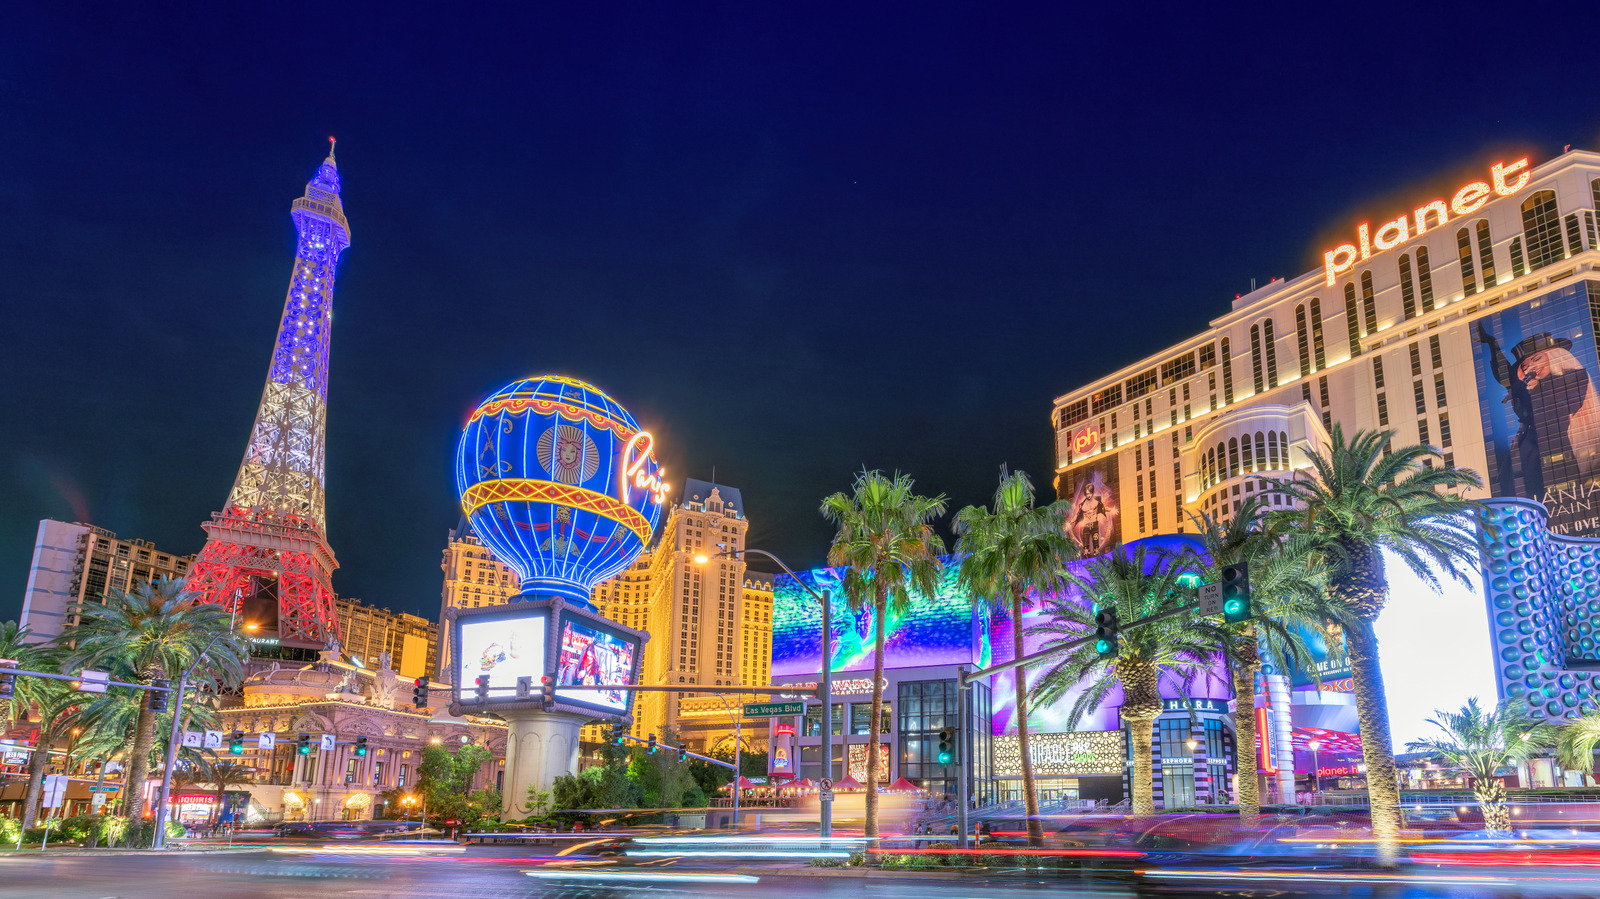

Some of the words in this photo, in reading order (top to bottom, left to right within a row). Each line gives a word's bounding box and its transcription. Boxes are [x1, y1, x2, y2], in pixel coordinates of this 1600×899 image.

[1324, 157, 1532, 287] planet
[1076, 427, 1098, 452] ph
[622, 431, 670, 504] Paris
[1205, 585, 1216, 593] NO
[248, 637, 279, 645] TAURANT
[760, 705, 783, 715] Vegas
[784, 704, 801, 712] Blvd
[1073, 753, 1096, 763] SHOPS
[1317, 766, 1349, 778] planet
